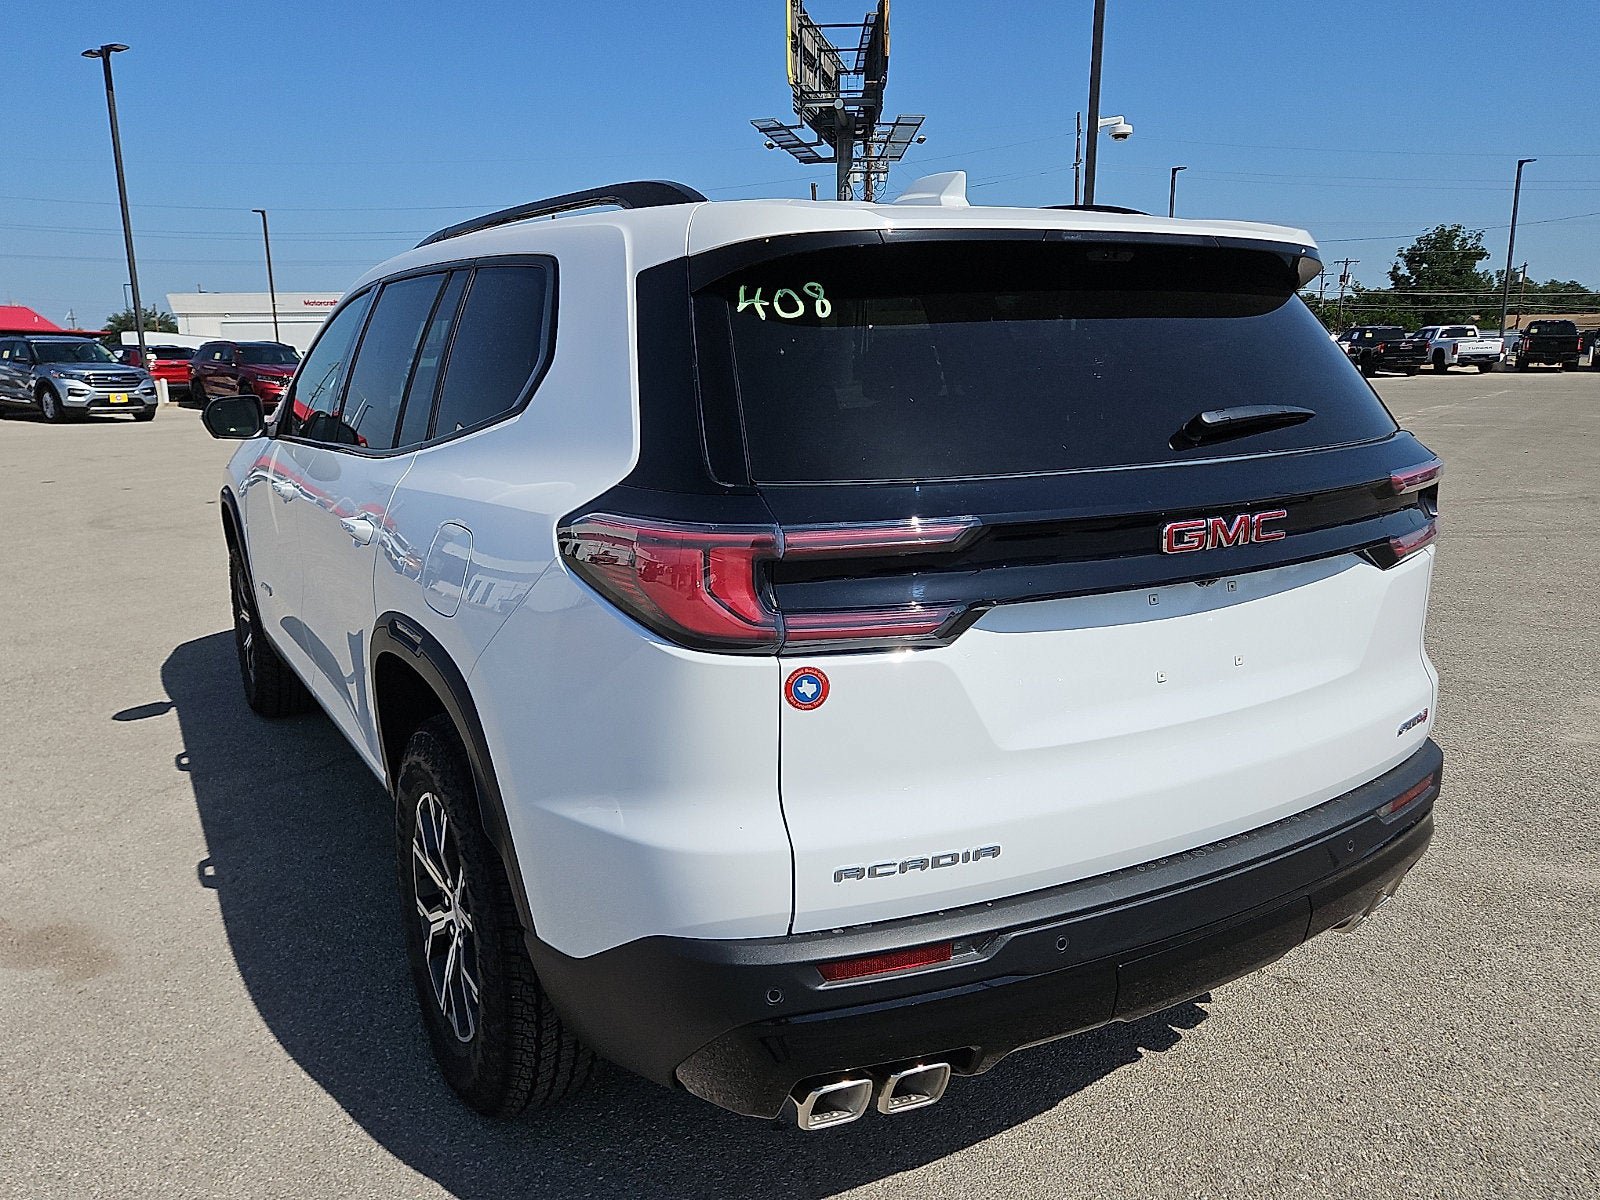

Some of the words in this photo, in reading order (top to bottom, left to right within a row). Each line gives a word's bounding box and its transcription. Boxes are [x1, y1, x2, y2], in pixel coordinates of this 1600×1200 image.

[737, 281, 832, 320] 408
[1162, 509, 1288, 555] GMC
[833, 844, 1001, 883] ACADIA
